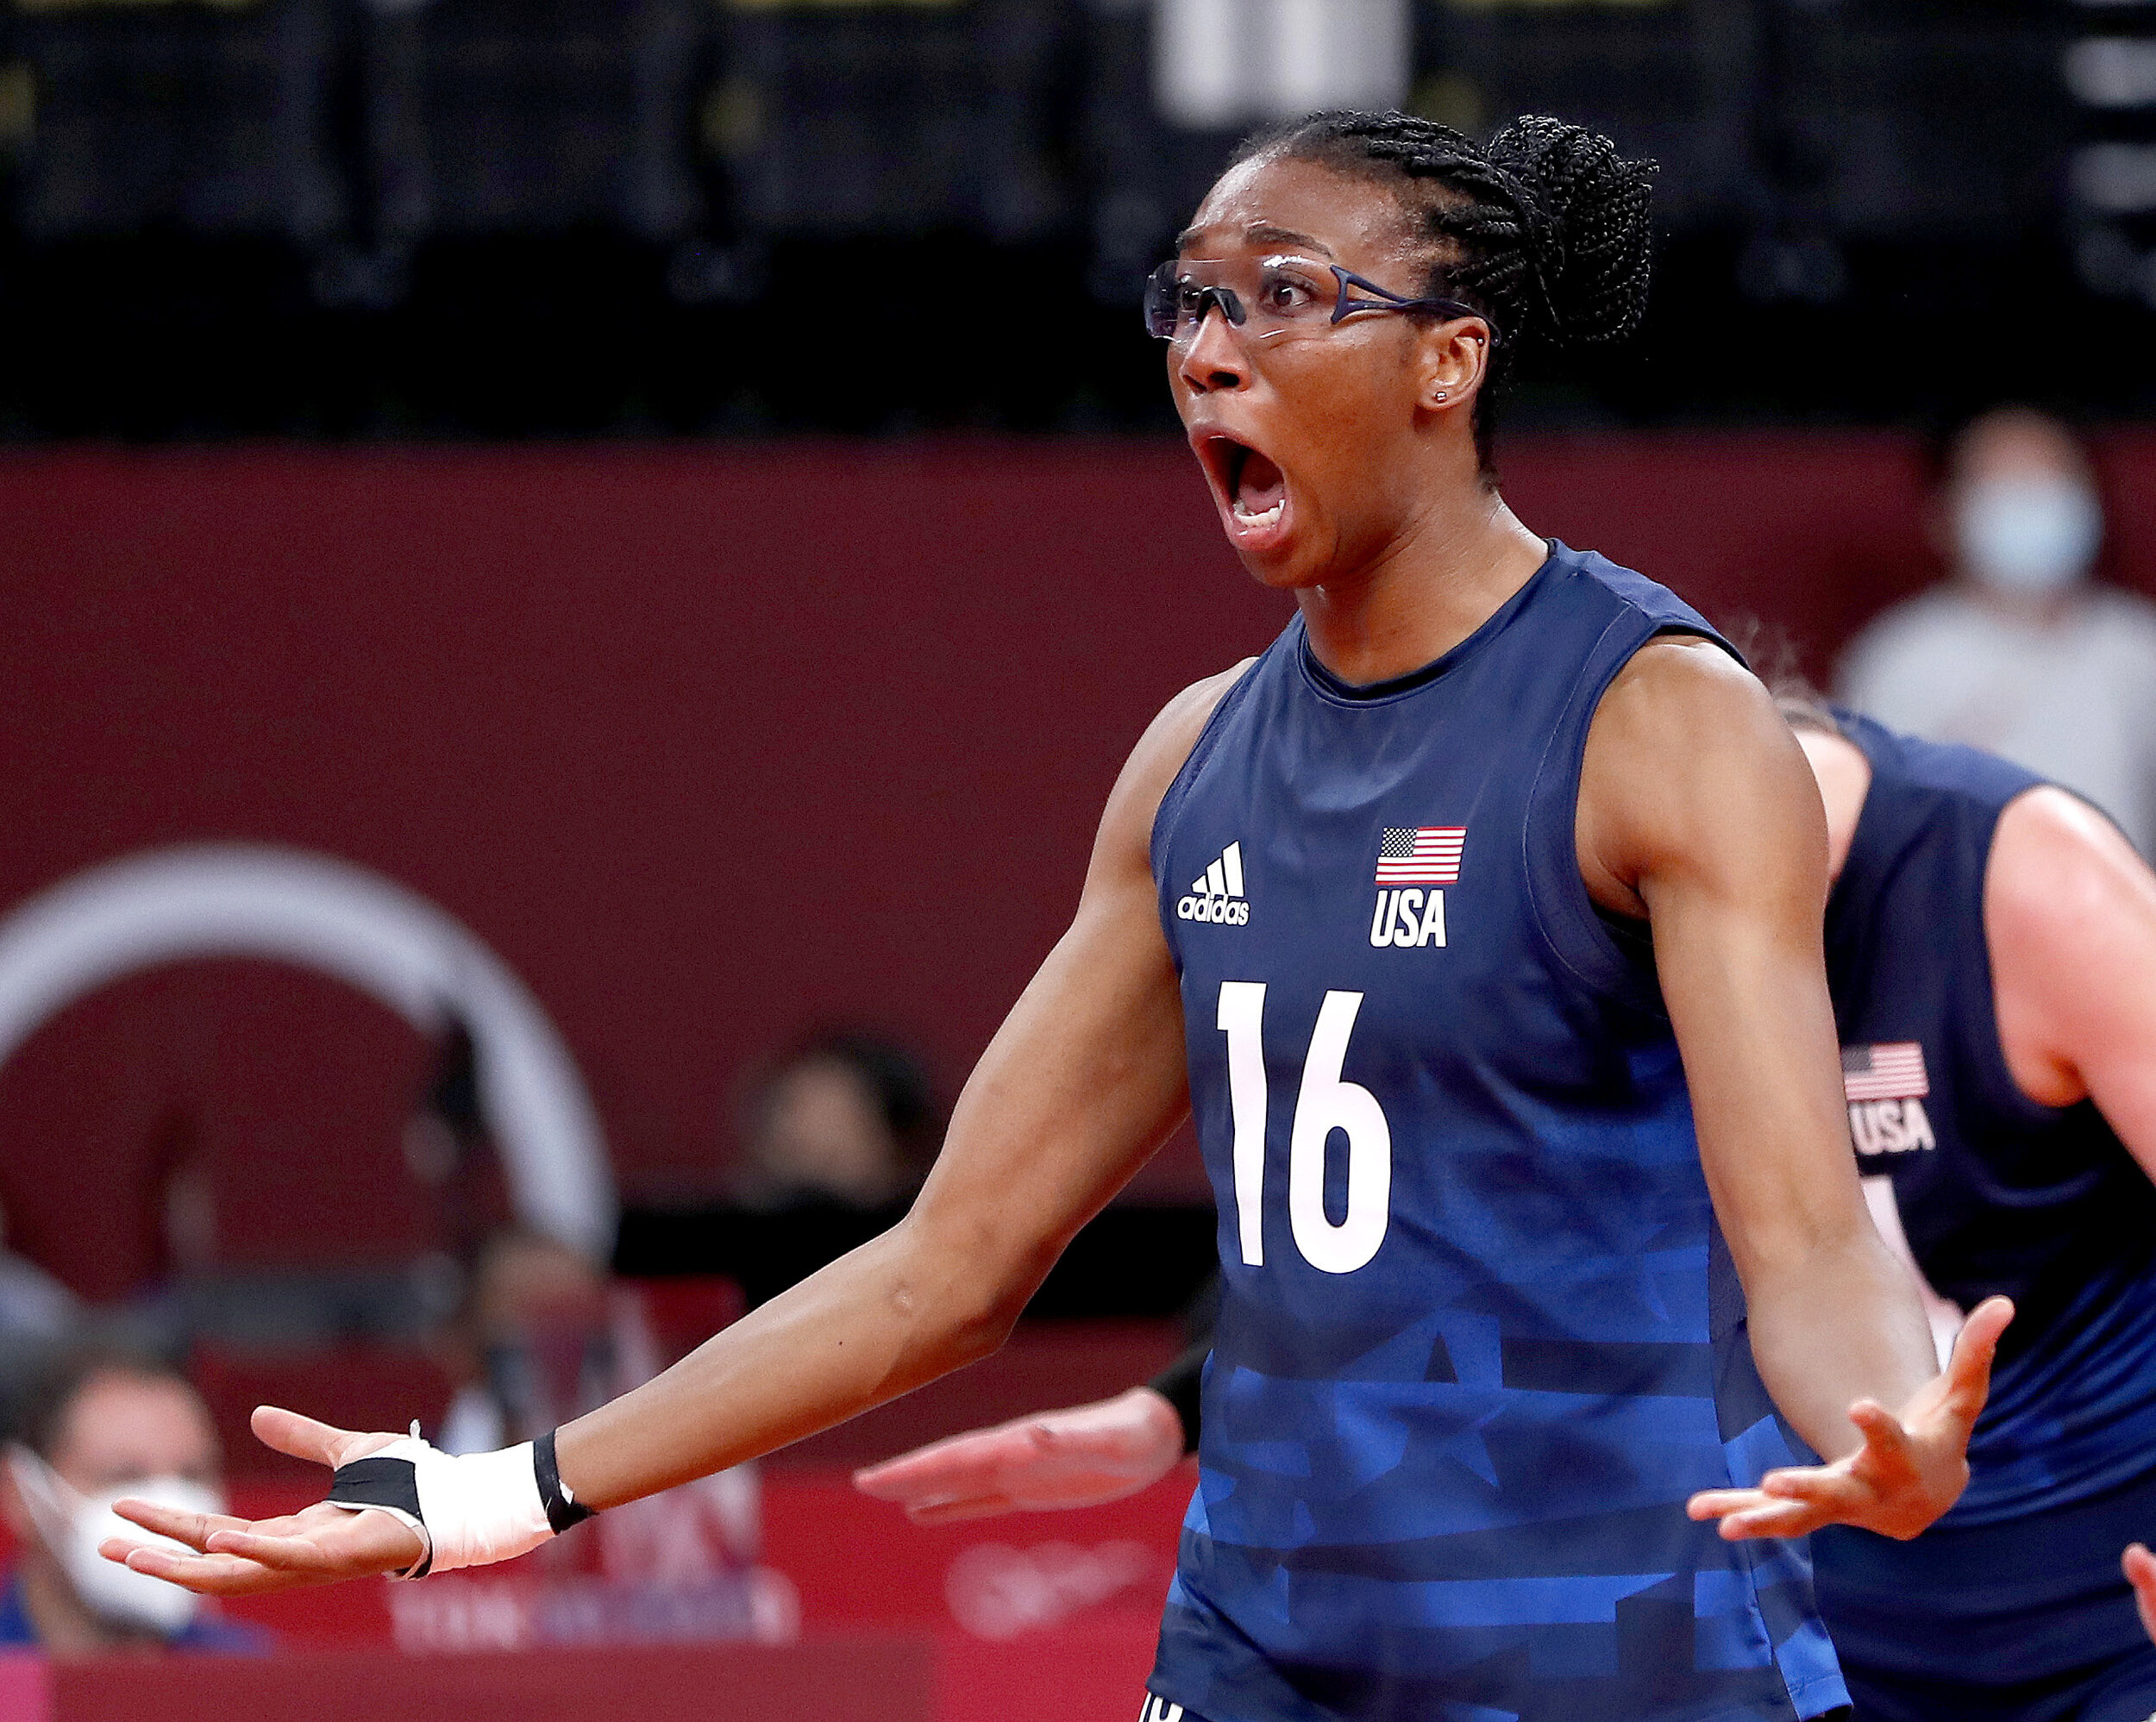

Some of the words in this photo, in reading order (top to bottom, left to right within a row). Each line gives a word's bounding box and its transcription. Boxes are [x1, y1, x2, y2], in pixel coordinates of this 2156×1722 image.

[1176, 892, 1250, 926] adidas
[1369, 888, 1447, 948] USA
[1217, 980, 1392, 1274] 16
[1848, 1099, 1936, 1155] USA
